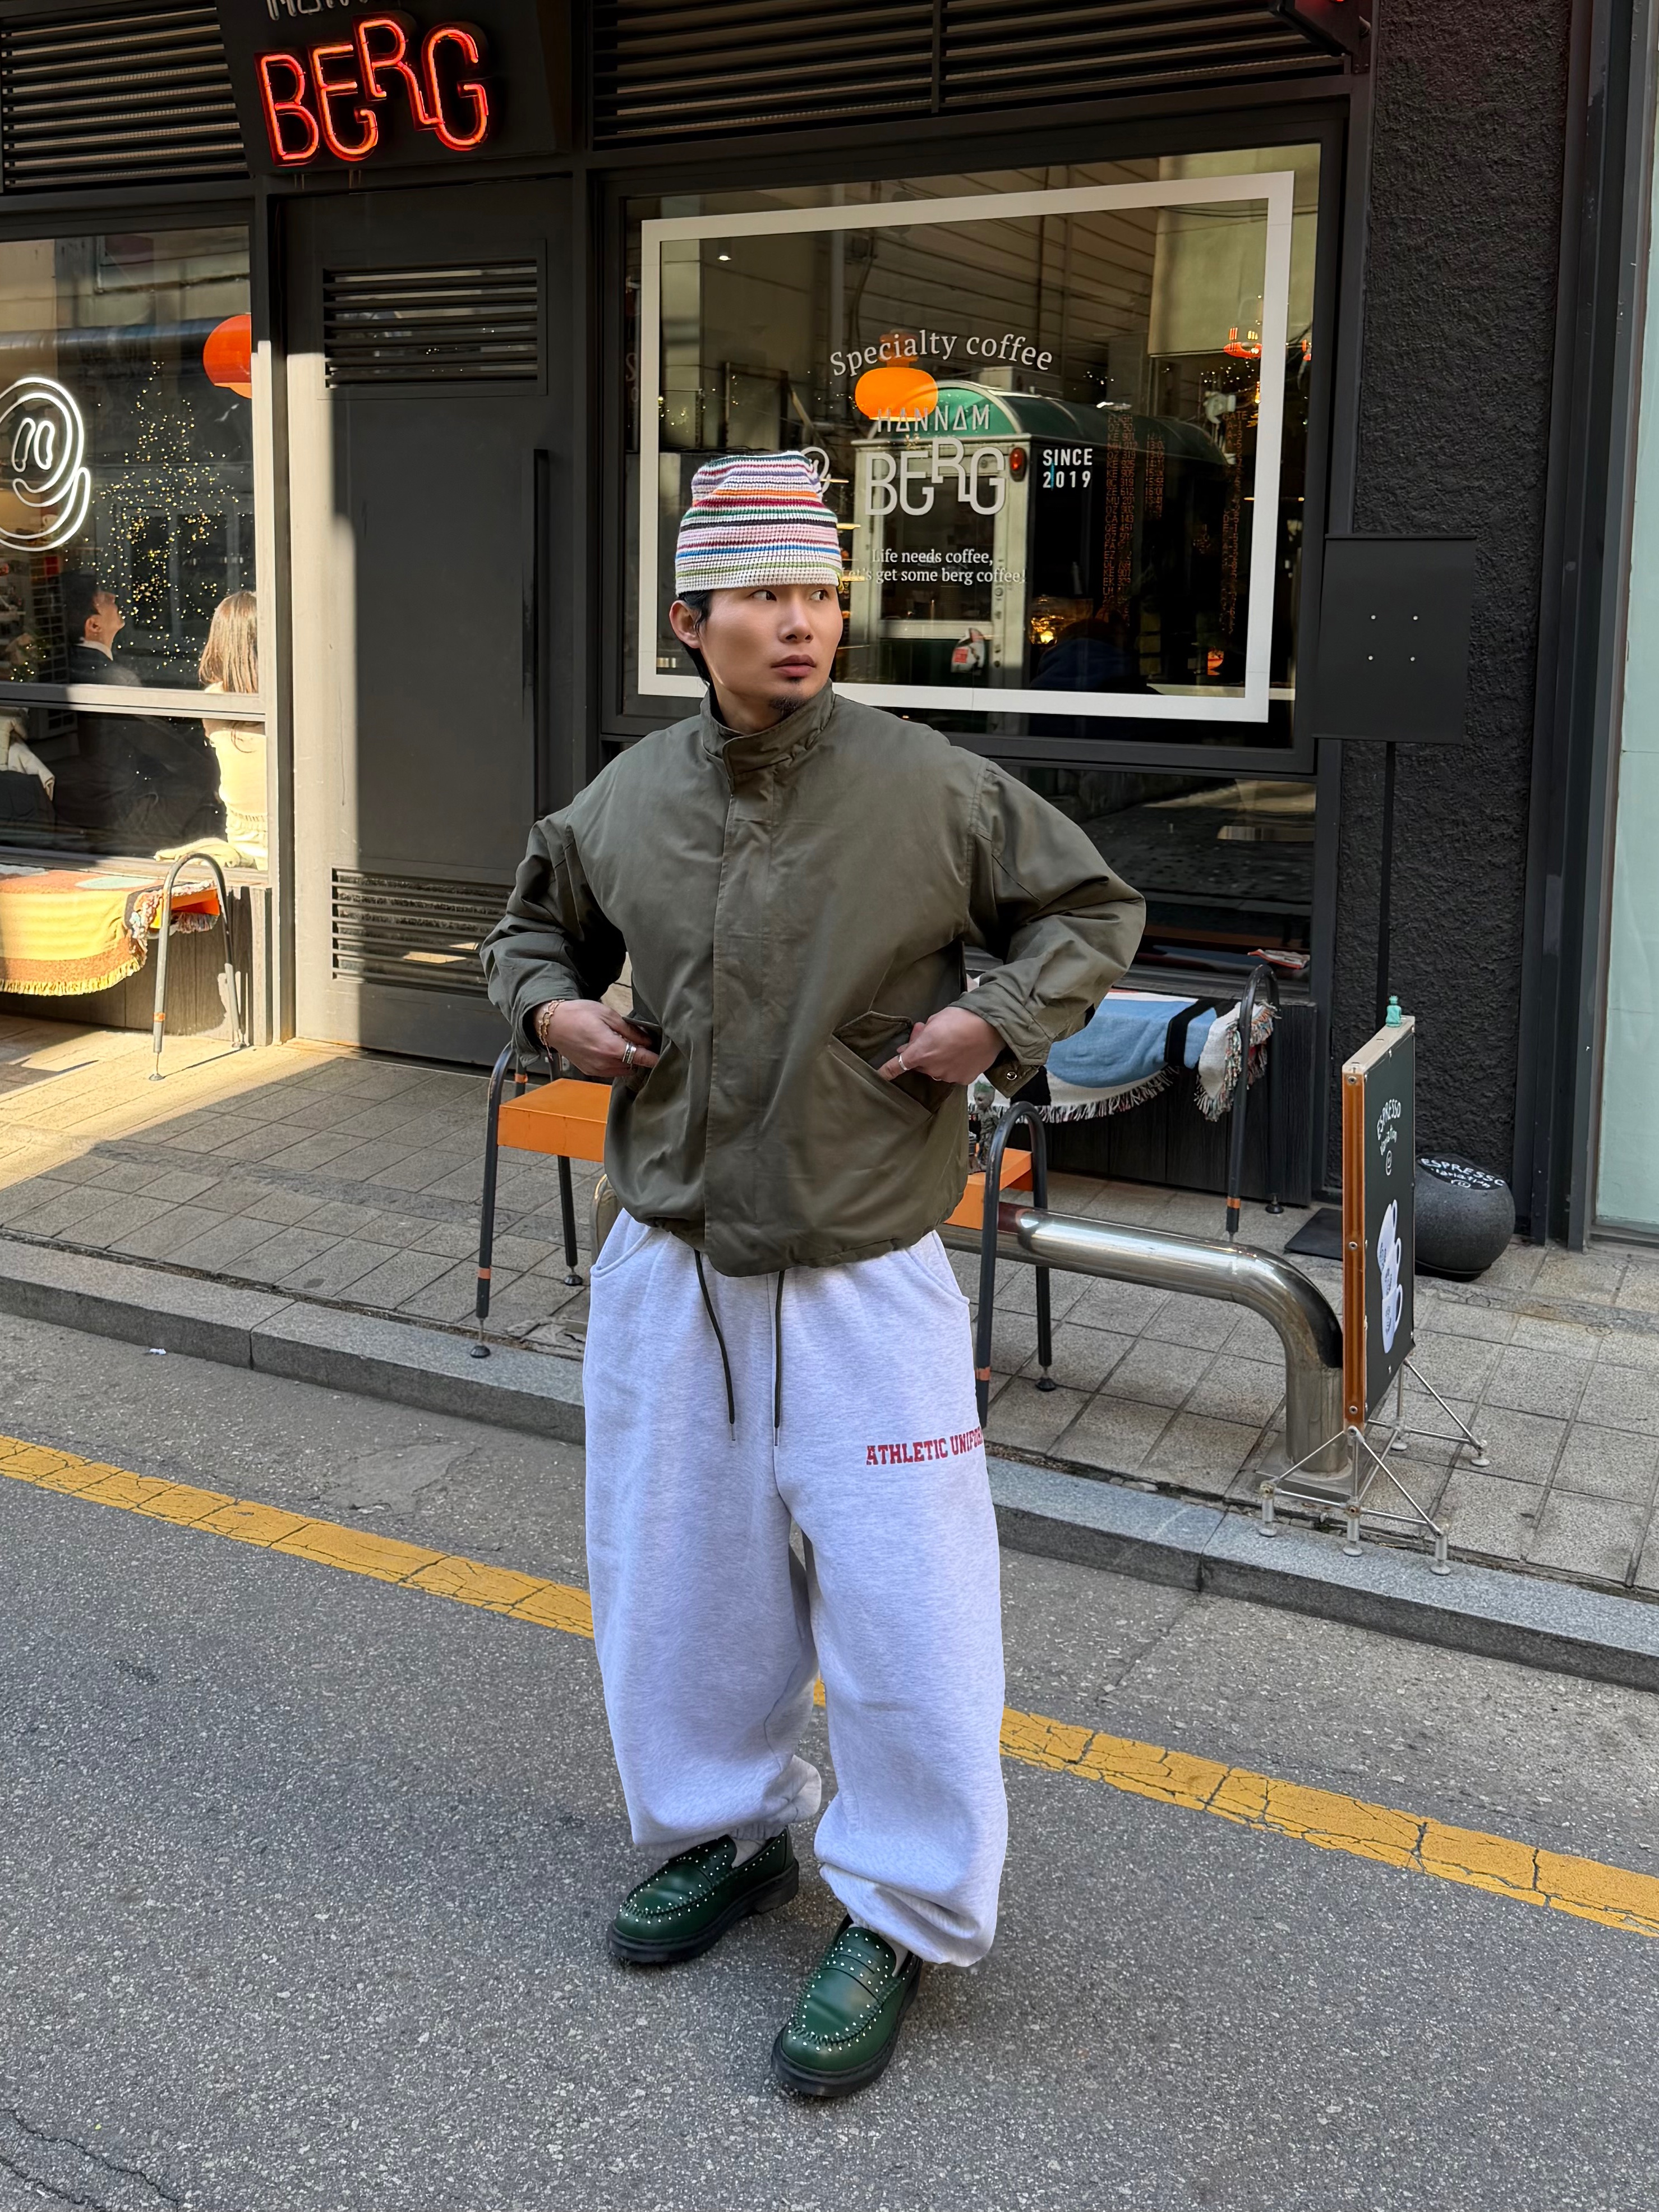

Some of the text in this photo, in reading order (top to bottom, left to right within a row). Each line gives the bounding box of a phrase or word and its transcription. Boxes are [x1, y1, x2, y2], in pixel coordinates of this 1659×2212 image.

[256, 13, 489, 165] BERG
[830, 329, 1053, 376] Specialty coffee
[878, 404, 989, 432] HANNAM
[1043, 448, 1093, 466] SINCE
[865, 438, 1005, 515] BERG
[1043, 471, 1091, 488] 2019
[872, 548, 993, 565] Life needs coffee,
[877, 569, 898, 584] get
[901, 571, 938, 582] some
[942, 568, 973, 586] berg
[976, 568, 1026, 583] coffee!
[867, 1438, 948, 1465] ATHLETIC
